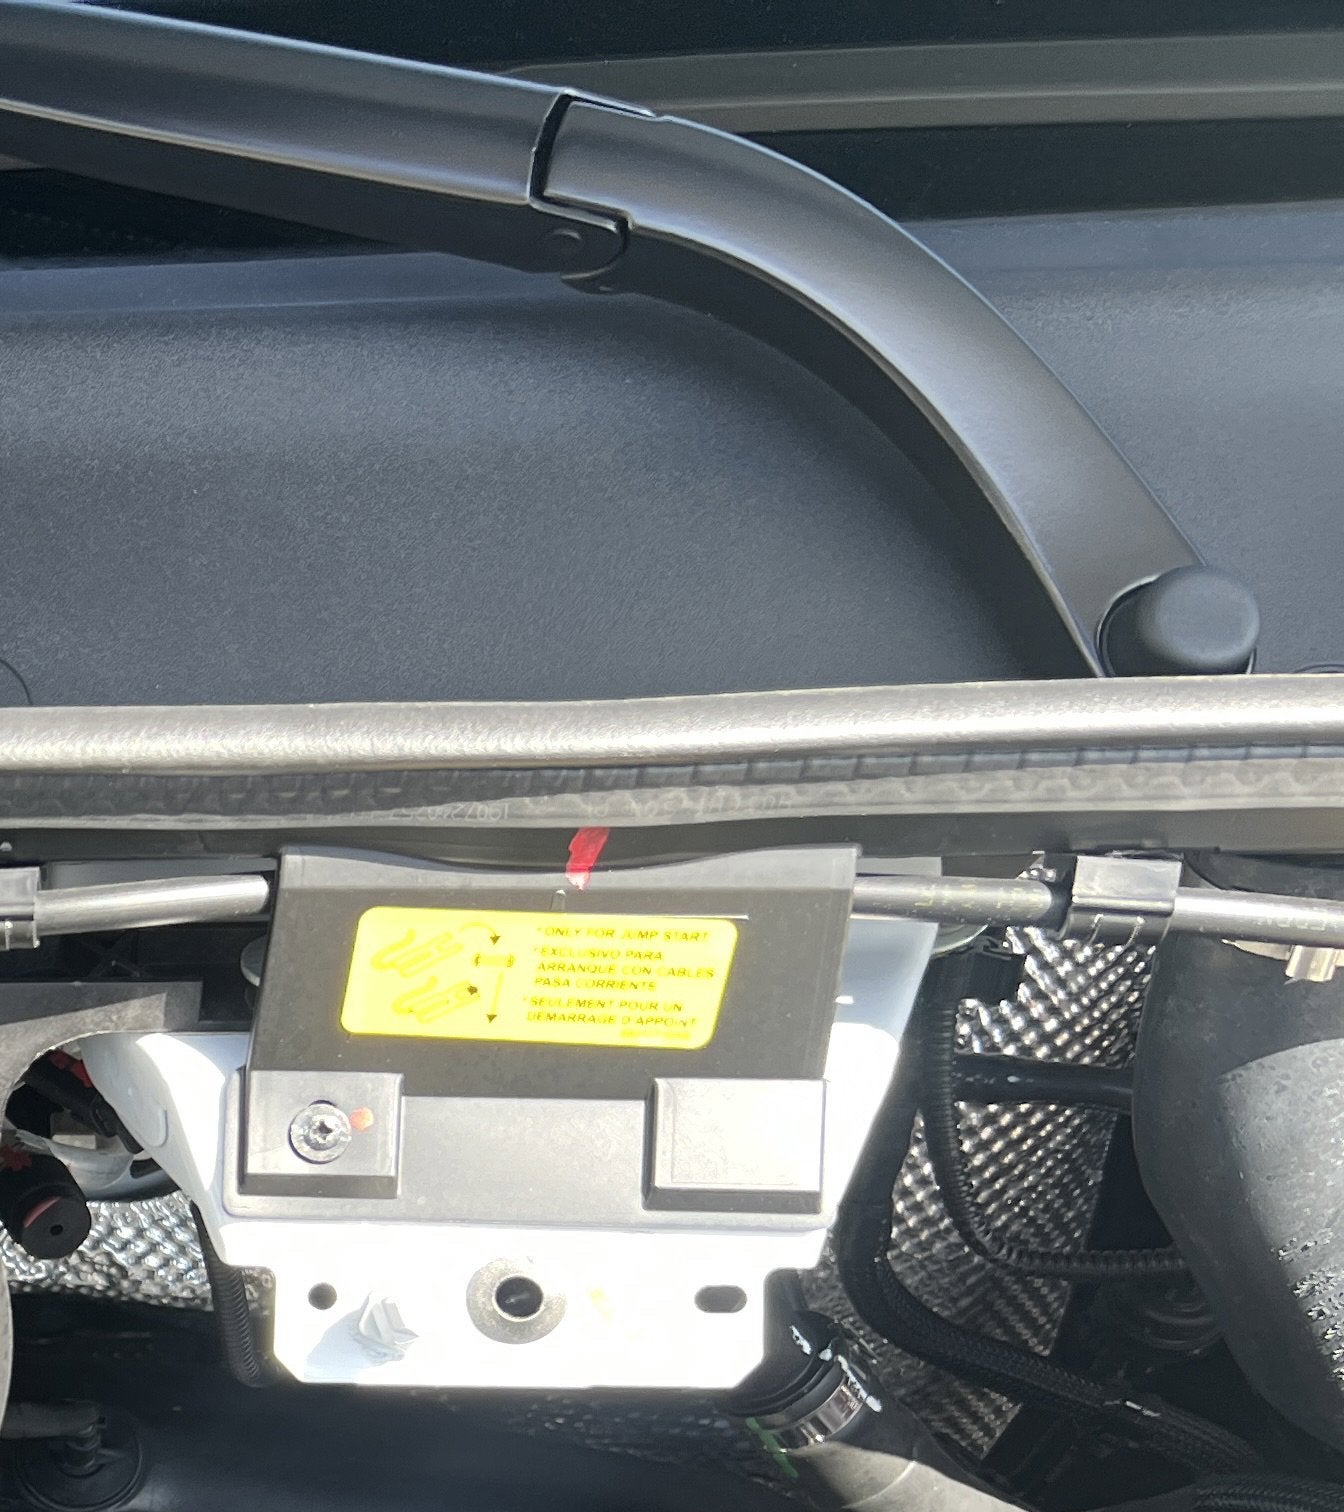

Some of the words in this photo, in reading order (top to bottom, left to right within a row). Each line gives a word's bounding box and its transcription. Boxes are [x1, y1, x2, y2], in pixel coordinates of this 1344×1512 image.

[545, 927, 581, 937] ONLY
[587, 928, 616, 938] FOR
[621, 929, 659, 940] JUMP
[664, 931, 709, 941] START
[540, 947, 621, 960] EXCLUSIVO
[626, 950, 663, 960] PARA
[537, 962, 616, 974] ARRANQUE
[622, 965, 652, 976] CON
[657, 966, 715, 978] CABLES
[533, 977, 571, 987] PASA
[576, 979, 656, 991] CORRIENTE
[530, 996, 614, 1009] SEULEMENT
[620, 1000, 658, 1011] POUR
[664, 1002, 683, 1012] UN
